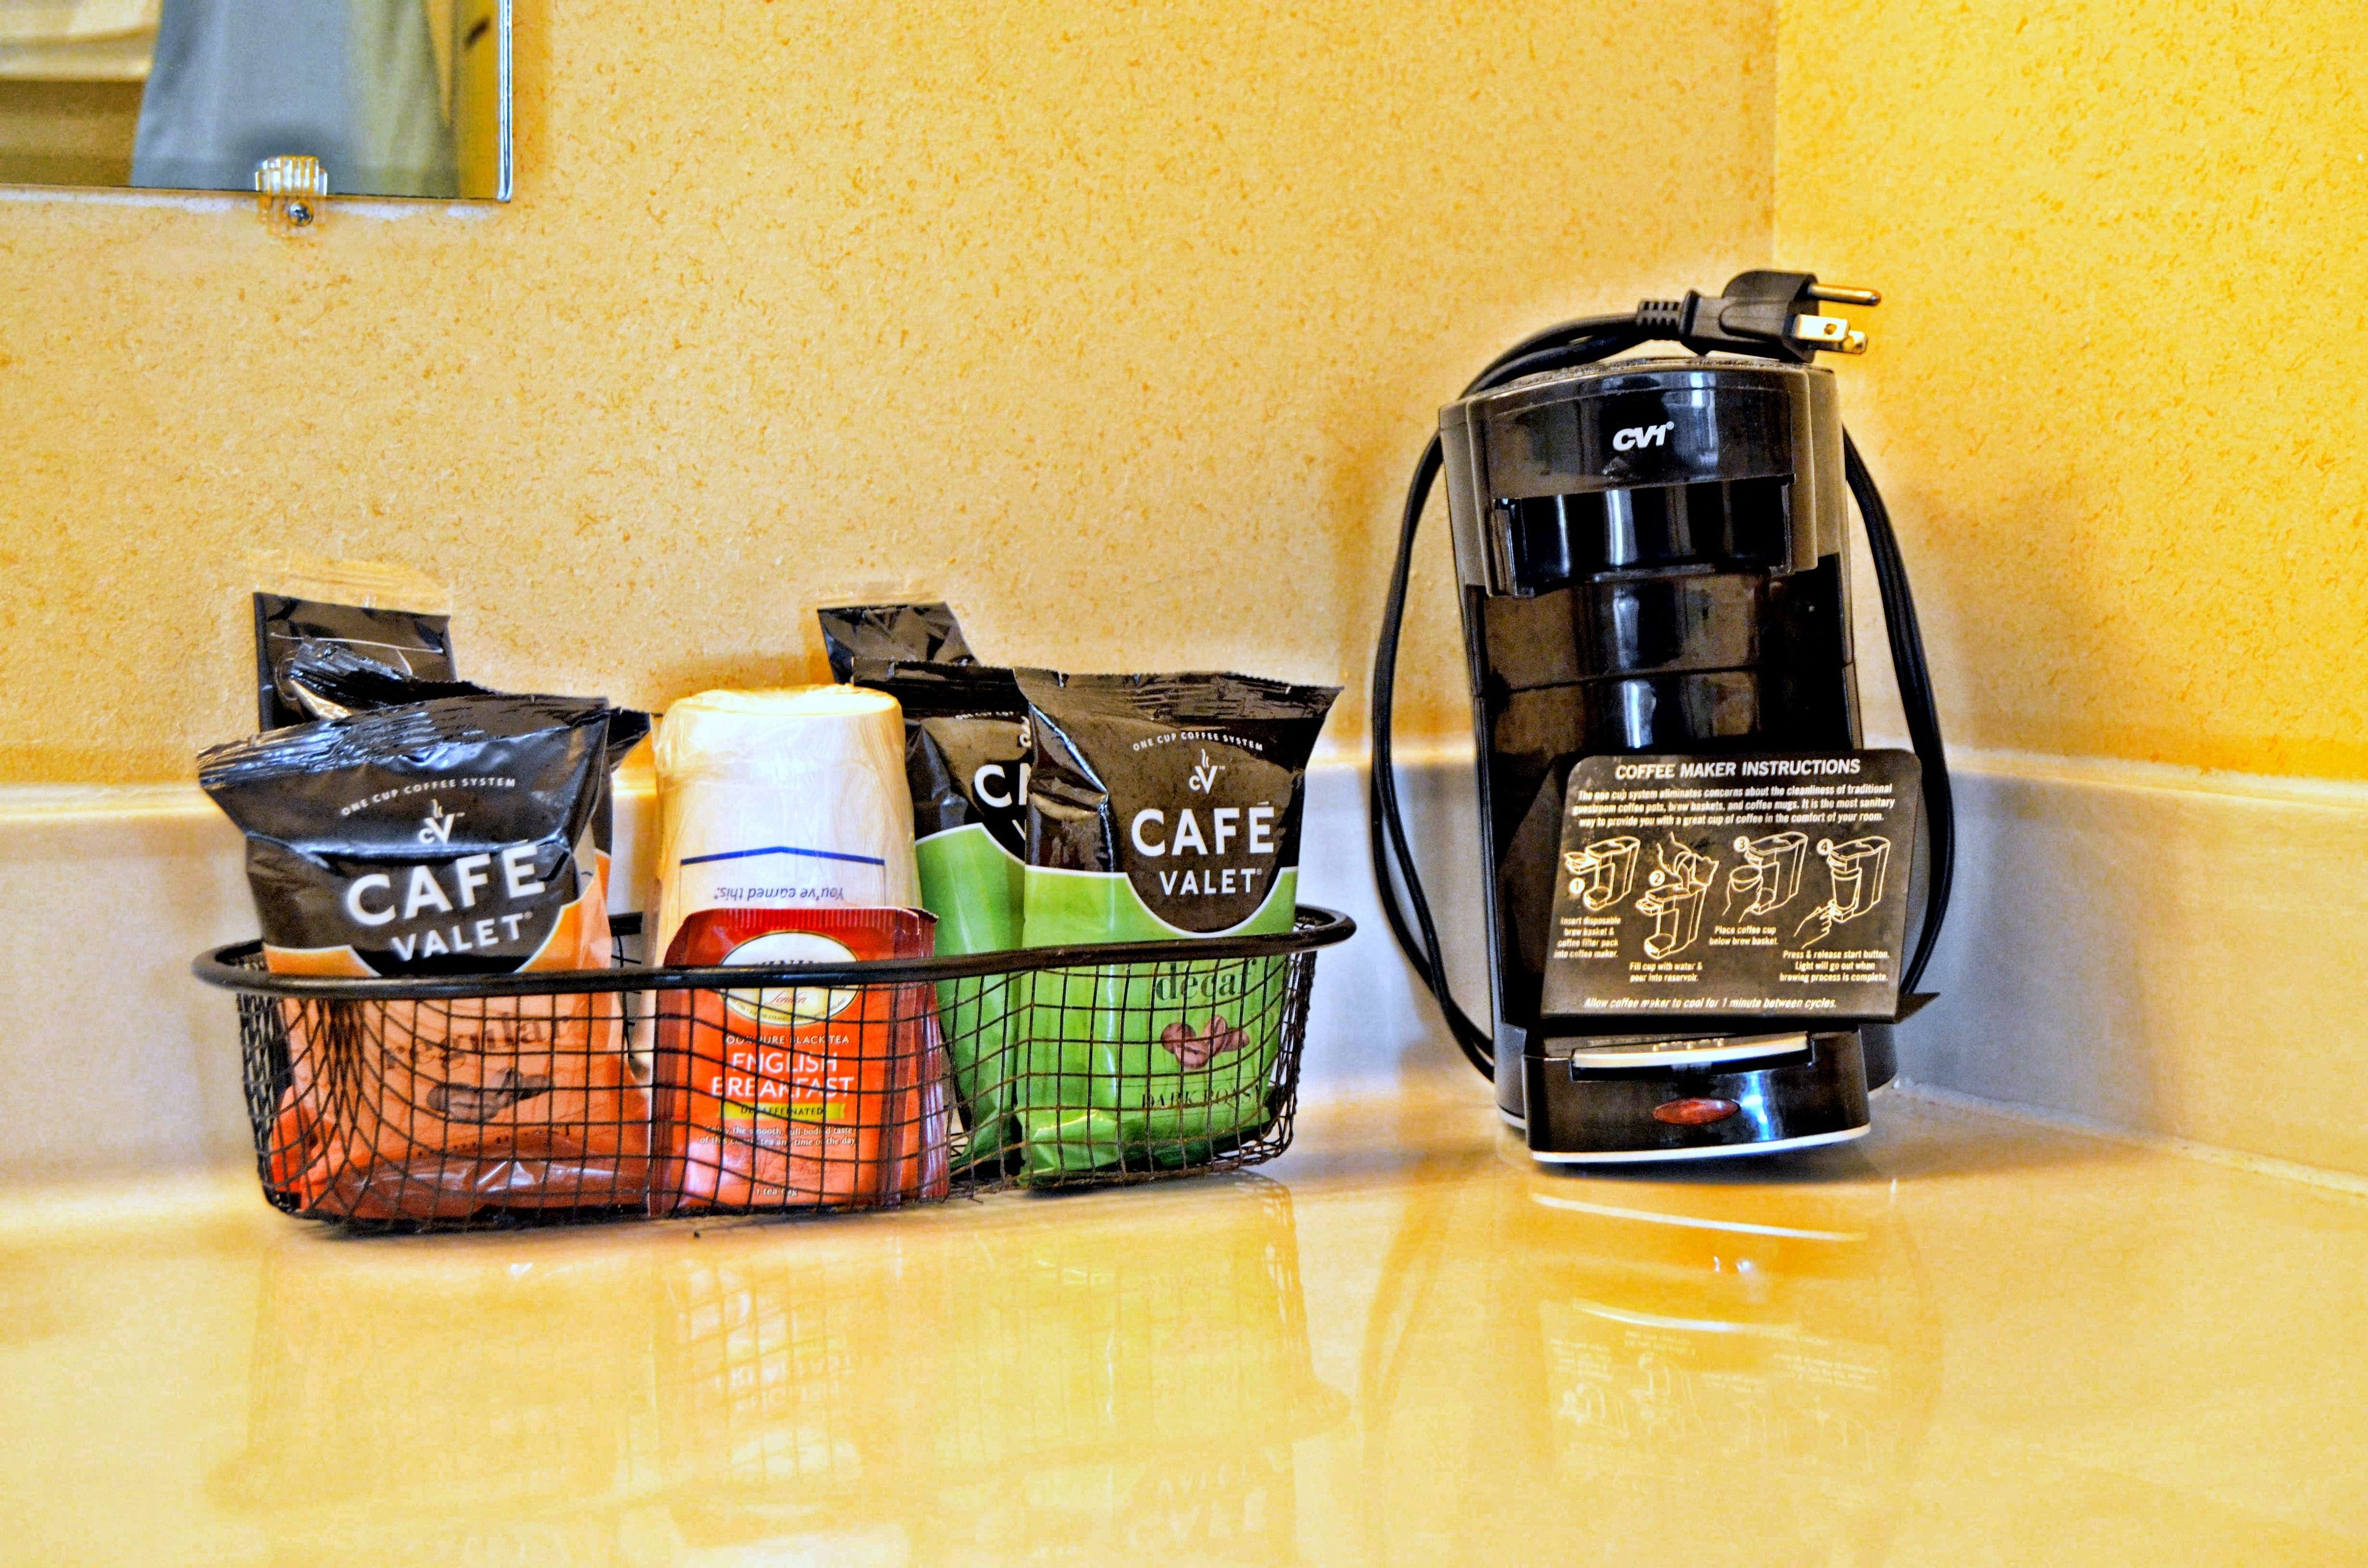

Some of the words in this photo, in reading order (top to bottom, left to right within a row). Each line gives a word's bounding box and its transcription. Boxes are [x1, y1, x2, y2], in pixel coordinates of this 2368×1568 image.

[1132, 737, 1154, 752] ONE
[1156, 733, 1177, 744] CUP
[1180, 731, 1219, 741] COFFEE
[1222, 734, 1263, 752] SYSTEM
[1614, 763, 1677, 781] COFFEE
[1679, 761, 1737, 779] MAKER
[1741, 758, 1860, 776] INSTRUCTIONS
[340, 798, 369, 816] ONE
[372, 789, 398, 803] CUP
[403, 779, 457, 795] COFFEE
[461, 777, 516, 787] SYSTEM
[1578, 790, 1593, 801] The
[1593, 791, 1610, 800] one
[1611, 790, 1627, 801] cup
[1629, 789, 1658, 800] system
[1659, 788, 1702, 799] eliminates
[1703, 788, 1743, 799] concerns
[1745, 786, 1769, 797] about
[1771, 786, 1785, 796] the
[1786, 785, 1835, 796] cleanliness
[1836, 784, 1846, 795] of
[1848, 784, 1893, 795] traditional
[1572, 803, 1616, 816] guestroom
[1618, 802, 1644, 813] coffee
[1645, 803, 1667, 814] pots,
[1668, 802, 1690, 811] brew
[1691, 801, 1725, 812] baskets,
[1727, 800, 1743, 811] and
[1745, 800, 1772, 810] coffee
[1774, 800, 1799, 811] mugs.
[1801, 799, 1809, 809] It
[1811, 799, 1819, 808] is
[1820, 798, 1835, 808] the
[1836, 798, 1857, 808] most
[1859, 797, 1895, 809] sanitary
[1578, 818, 1596, 827] way
[1597, 817, 1606, 826] to
[1607, 816, 1638, 828] provide
[1639, 816, 1655, 827] you
[1656, 815, 1674, 825] with
[1682, 815, 1706, 827] great
[1708, 816, 1724, 826] cup
[1725, 813, 1734, 824] of
[1735, 813, 1763, 824] coffee
[1765, 813, 1773, 823] in
[1775, 813, 1789, 823] the
[1791, 812, 1825, 823] comfort
[1827, 811, 1836, 821] of
[1838, 812, 1857, 824] your
[1859, 812, 1885, 821] room.
[1159, 868, 1257, 897] VALET
[747, 887, 796, 901] earned
[800, 887, 844, 901] You've
[1560, 916, 1581, 925] Insert
[1583, 916, 1621, 926] disposable
[1564, 927, 1581, 936] brew
[1583, 927, 1607, 936] basket
[1714, 926, 1735, 934] Place
[1737, 926, 1761, 934] coffee
[1762, 926, 1777, 935] cup
[391, 913, 525, 962] VALET
[1557, 938, 1580, 948] coffee
[1581, 938, 1599, 947] filter
[1600, 938, 1619, 948] pack
[1709, 937, 1731, 945] below
[1732, 937, 1750, 945] brew
[1752, 937, 1778, 946] basket.
[1554, 950, 1568, 959] into
[1569, 950, 1592, 958] coffee
[1594, 949, 1619, 958] maker.
[1783, 950, 1804, 959] Press
[1814, 950, 1841, 958] release
[1843, 950, 1862, 959] start
[1863, 950, 1889, 958] button.
[1629, 961, 1642, 971] Fill
[1642, 963, 1656, 972] cup
[1658, 961, 1672, 971] with
[1674, 963, 1695, 971] water
[1795, 961, 1814, 972] Light
[1815, 961, 1828, 970] will
[1830, 963, 1840, 972] go
[1841, 962, 1854, 970] out
[1856, 961, 1875, 970] when
[1630, 974, 1648, 983] pour
[1649, 974, 1663, 982] into
[1664, 973, 1698, 982] reservoir.
[1779, 972, 1809, 983] brewing
[1811, 974, 1841, 983] process
[1843, 973, 1849, 982] is
[1851, 972, 1888, 982] complete.
[1584, 998, 1608, 1008] Allow
[1610, 998, 1638, 1008] coffee
[1641, 998, 1671, 1008] maker
[1672, 998, 1682, 1008] to
[1684, 997, 1704, 1008] cool
[1705, 997, 1719, 1008] for
[1730, 998, 1762, 1008] minute
[1764, 998, 1803, 1008] between
[1804, 998, 1837, 1009] cycles.
[828, 1035, 850, 1045] TEA
[732, 1051, 838, 1074] ENGLISH
[711, 1076, 855, 1098] BREAKFAST
[740, 1104, 824, 1117] DEAFFEINATED
[732, 1125, 746, 1135] the
[787, 1126, 831, 1135] ull-bodid
[833, 1126, 852, 1135] taste
[711, 1136, 728, 1146] ths
[776, 1138, 792, 1147] an
[794, 1138, 813, 1147] time
[826, 1136, 839, 1146] the
[763, 1188, 778, 1196] tea
